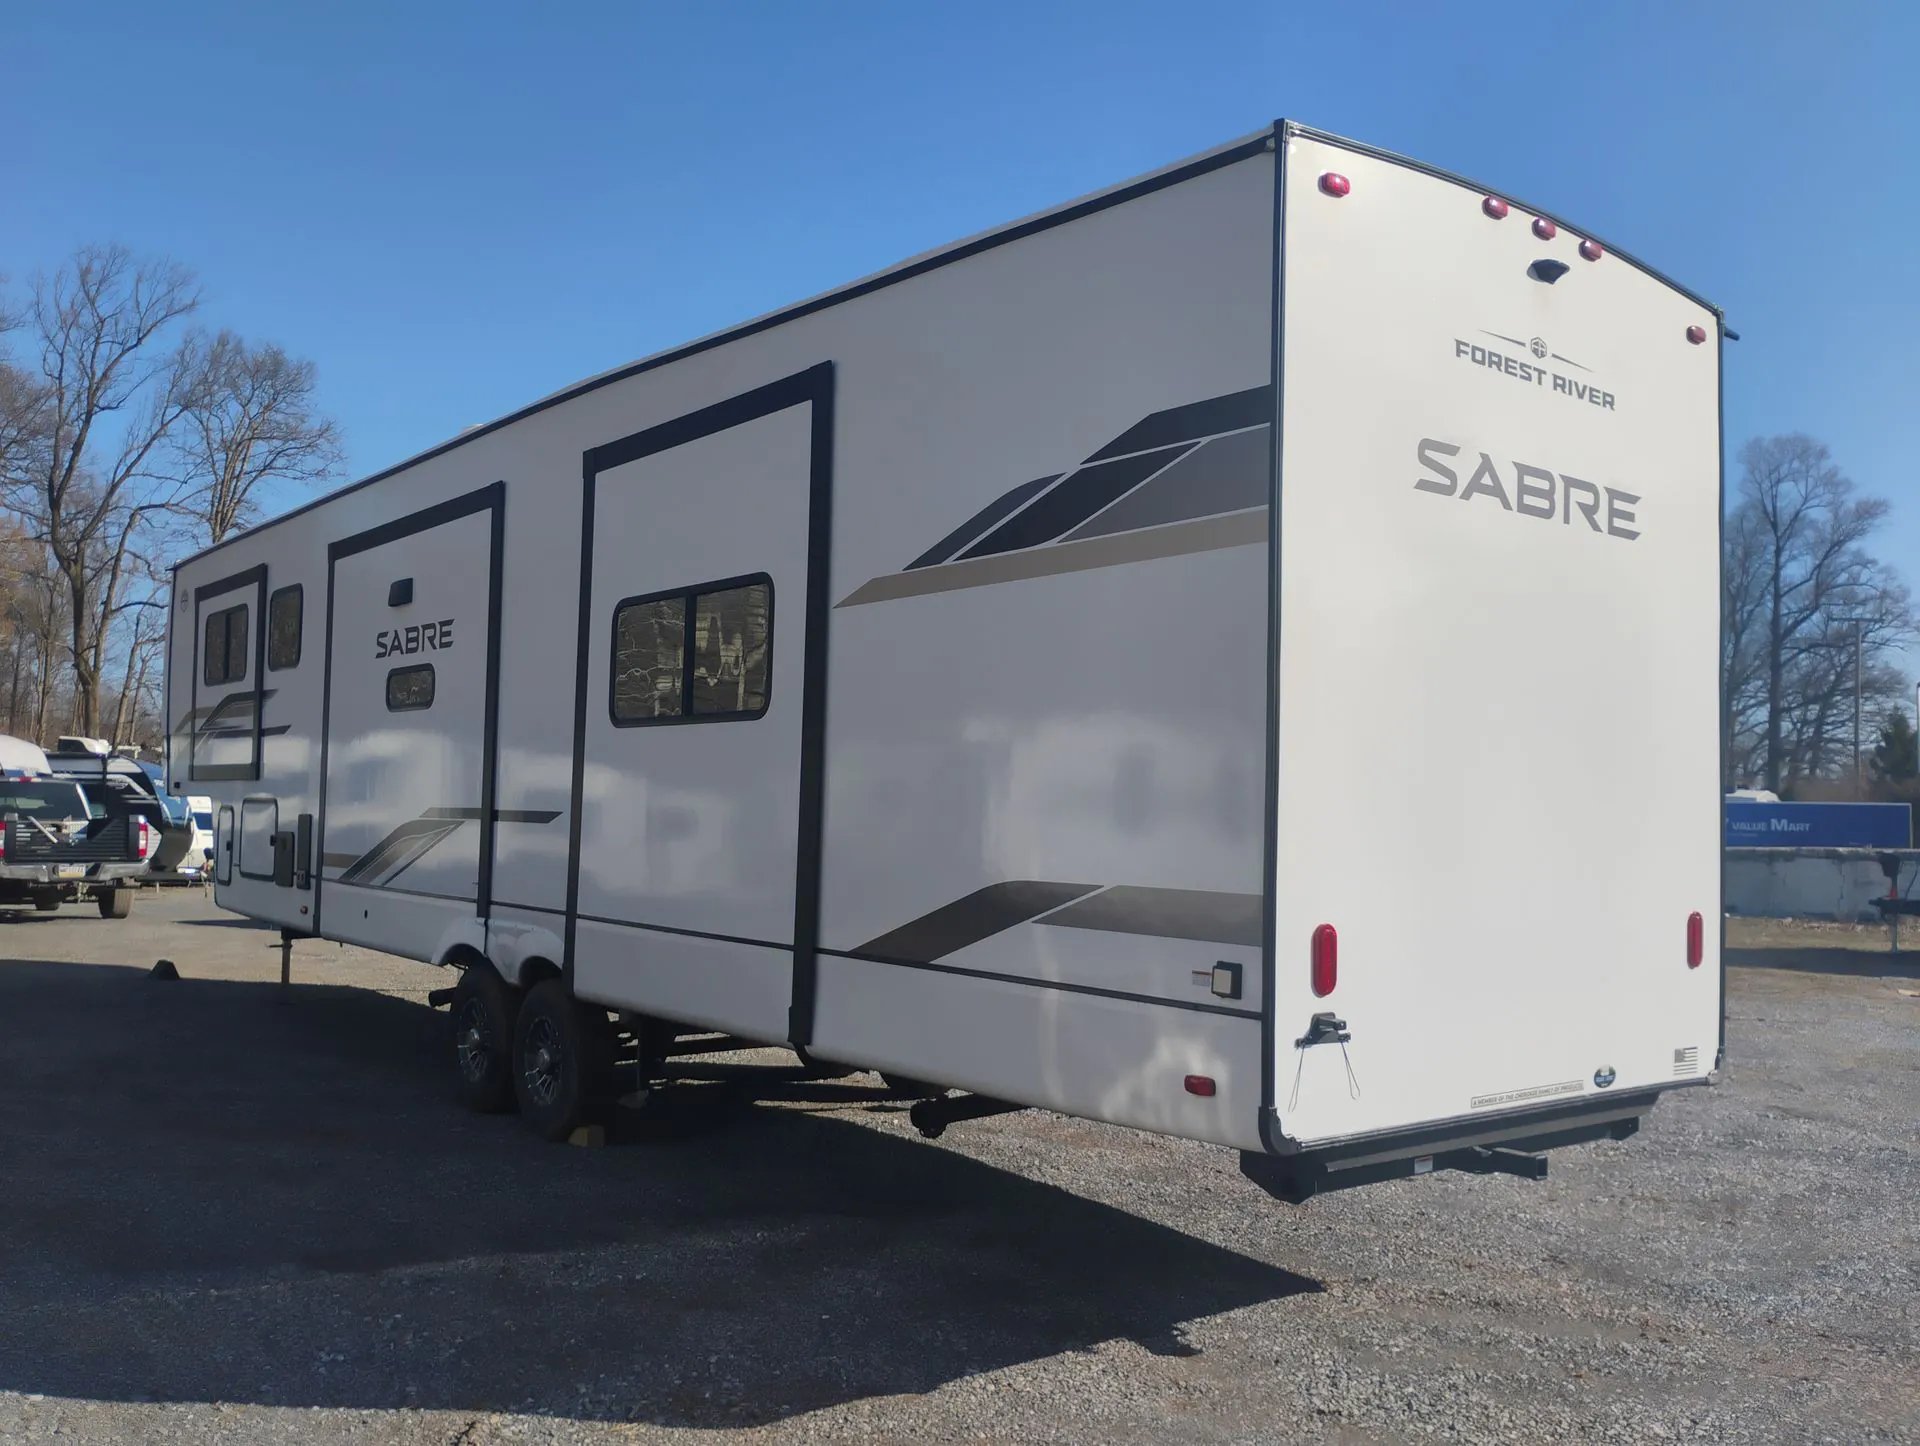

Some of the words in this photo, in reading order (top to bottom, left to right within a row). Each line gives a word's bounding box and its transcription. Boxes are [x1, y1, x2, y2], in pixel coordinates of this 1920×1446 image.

[1454, 338, 1547, 386] FOREST
[1552, 373, 1616, 411] RIVER
[1413, 438, 1642, 541] SABRE
[375, 618, 455, 659] SABRE
[1732, 822, 1768, 832] VALUE
[1477, 1096, 1497, 1106] MEMBER
[1505, 1093, 1514, 1101] THE
